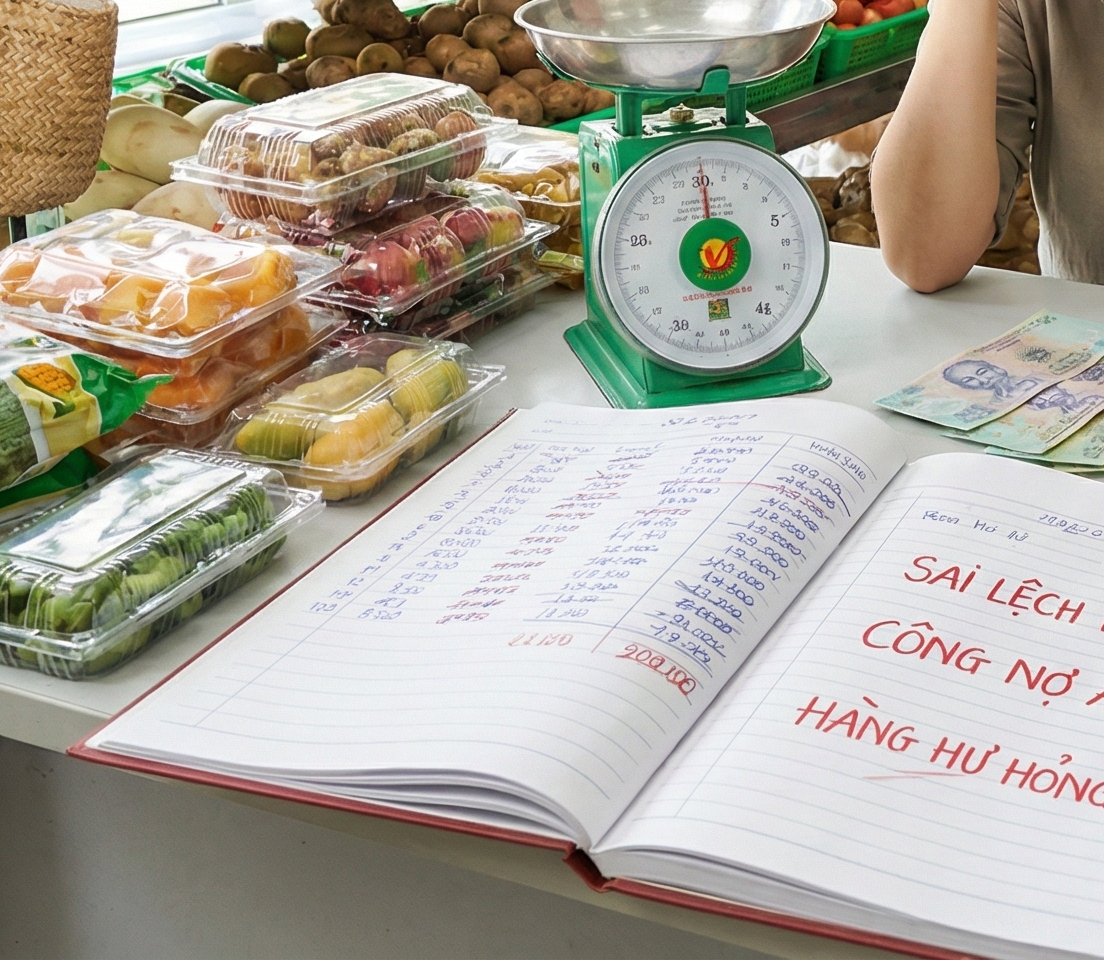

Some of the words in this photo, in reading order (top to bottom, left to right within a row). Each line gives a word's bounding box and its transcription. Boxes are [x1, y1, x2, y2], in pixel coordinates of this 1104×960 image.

[987, 578, 1085, 624] LỆCH
[863, 621, 991, 675] CÔNG
[1005, 659, 1079, 707] NỢ
[795, 696, 919, 753] HÀNG
[930, 736, 1000, 775] HƯ
